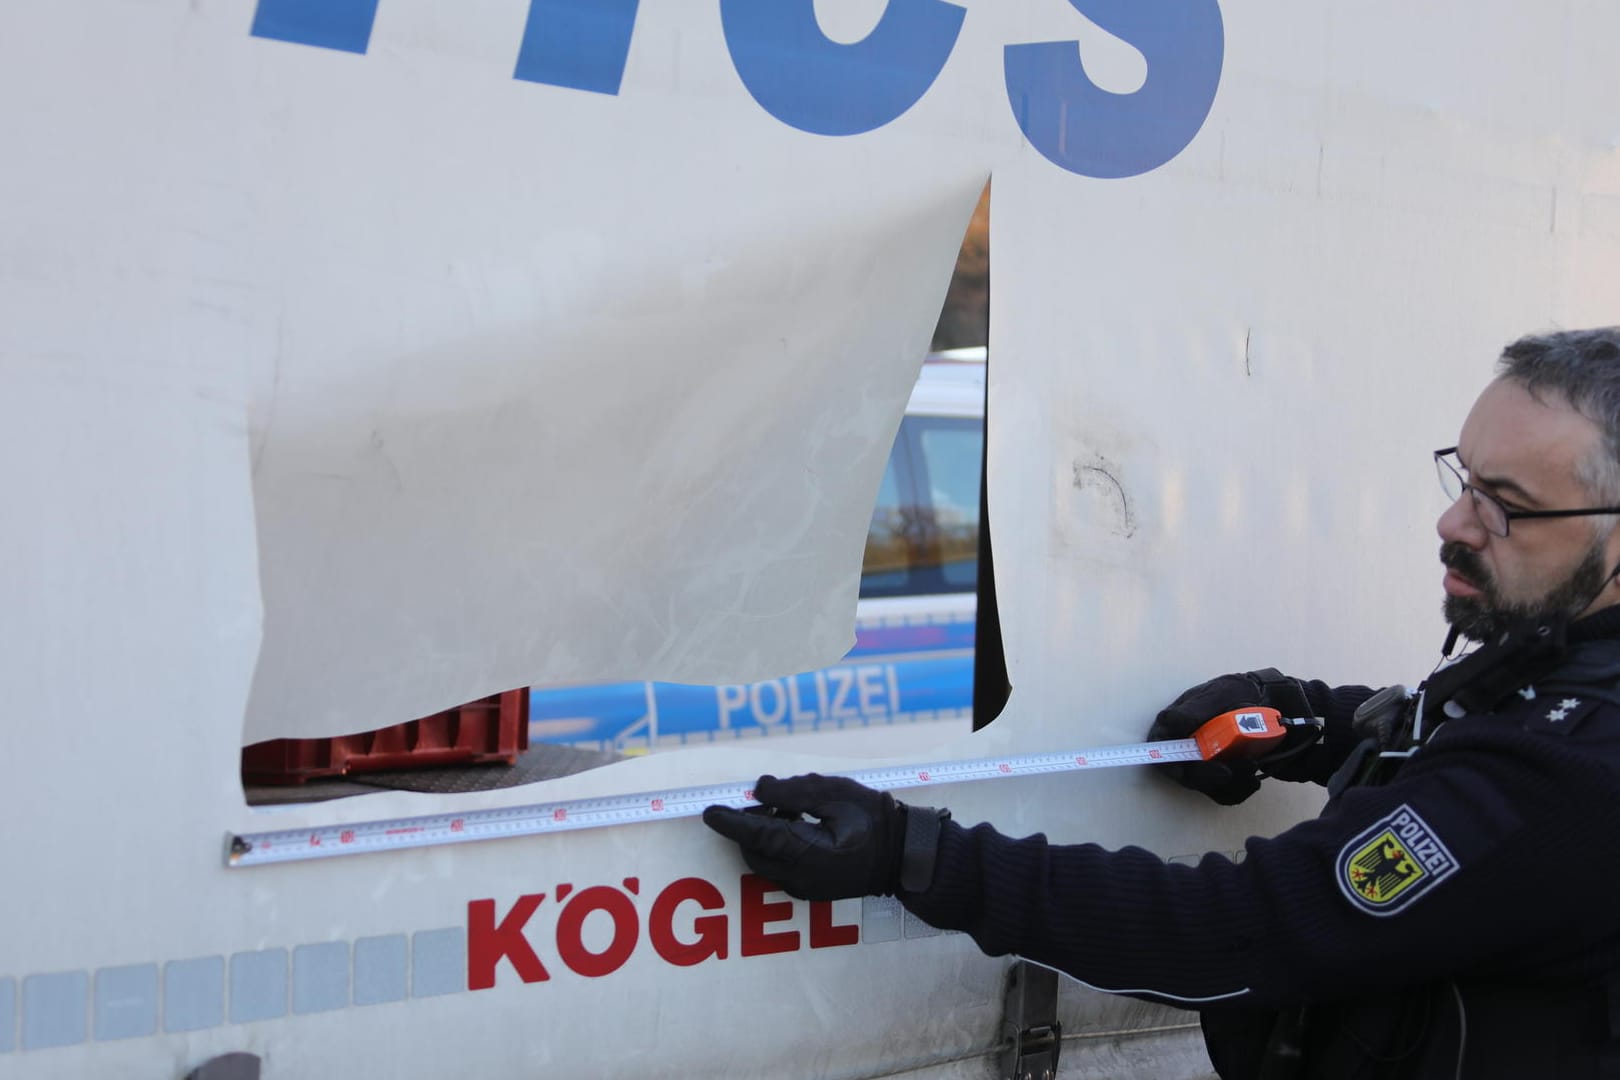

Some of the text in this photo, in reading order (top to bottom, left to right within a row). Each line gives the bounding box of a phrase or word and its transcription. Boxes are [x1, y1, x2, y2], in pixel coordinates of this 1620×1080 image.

[716, 663, 899, 729] POLIZEI
[1390, 811, 1452, 877] POLIZEI
[467, 873, 860, 991] KÖGEL
